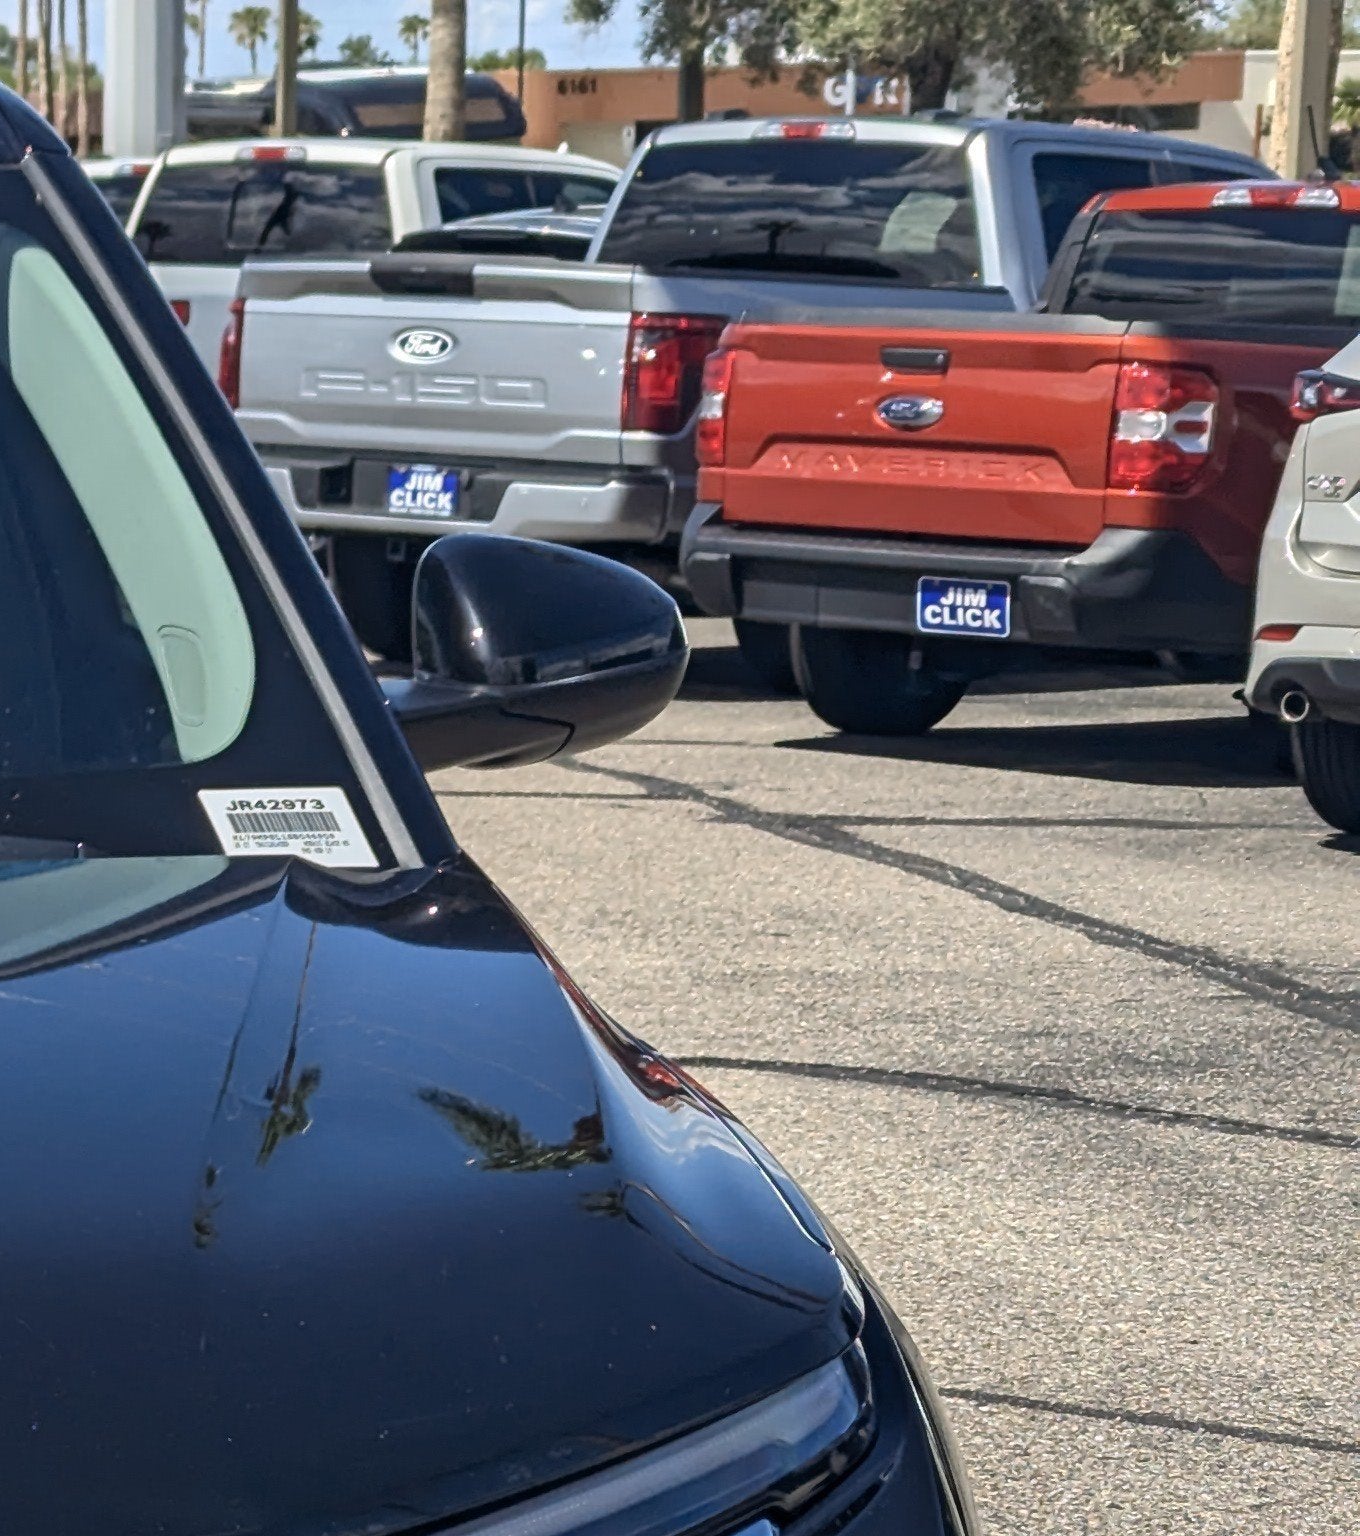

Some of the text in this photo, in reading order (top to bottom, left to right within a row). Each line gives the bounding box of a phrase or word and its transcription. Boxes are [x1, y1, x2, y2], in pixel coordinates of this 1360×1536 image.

[404, 332, 444, 355] Ford
[300, 368, 548, 409] F-150
[404, 472, 444, 492] JIM
[389, 489, 454, 511] CLICK
[940, 586, 988, 608] JIM
[923, 605, 1003, 630] CLICK
[226, 799, 326, 811] JR42973
